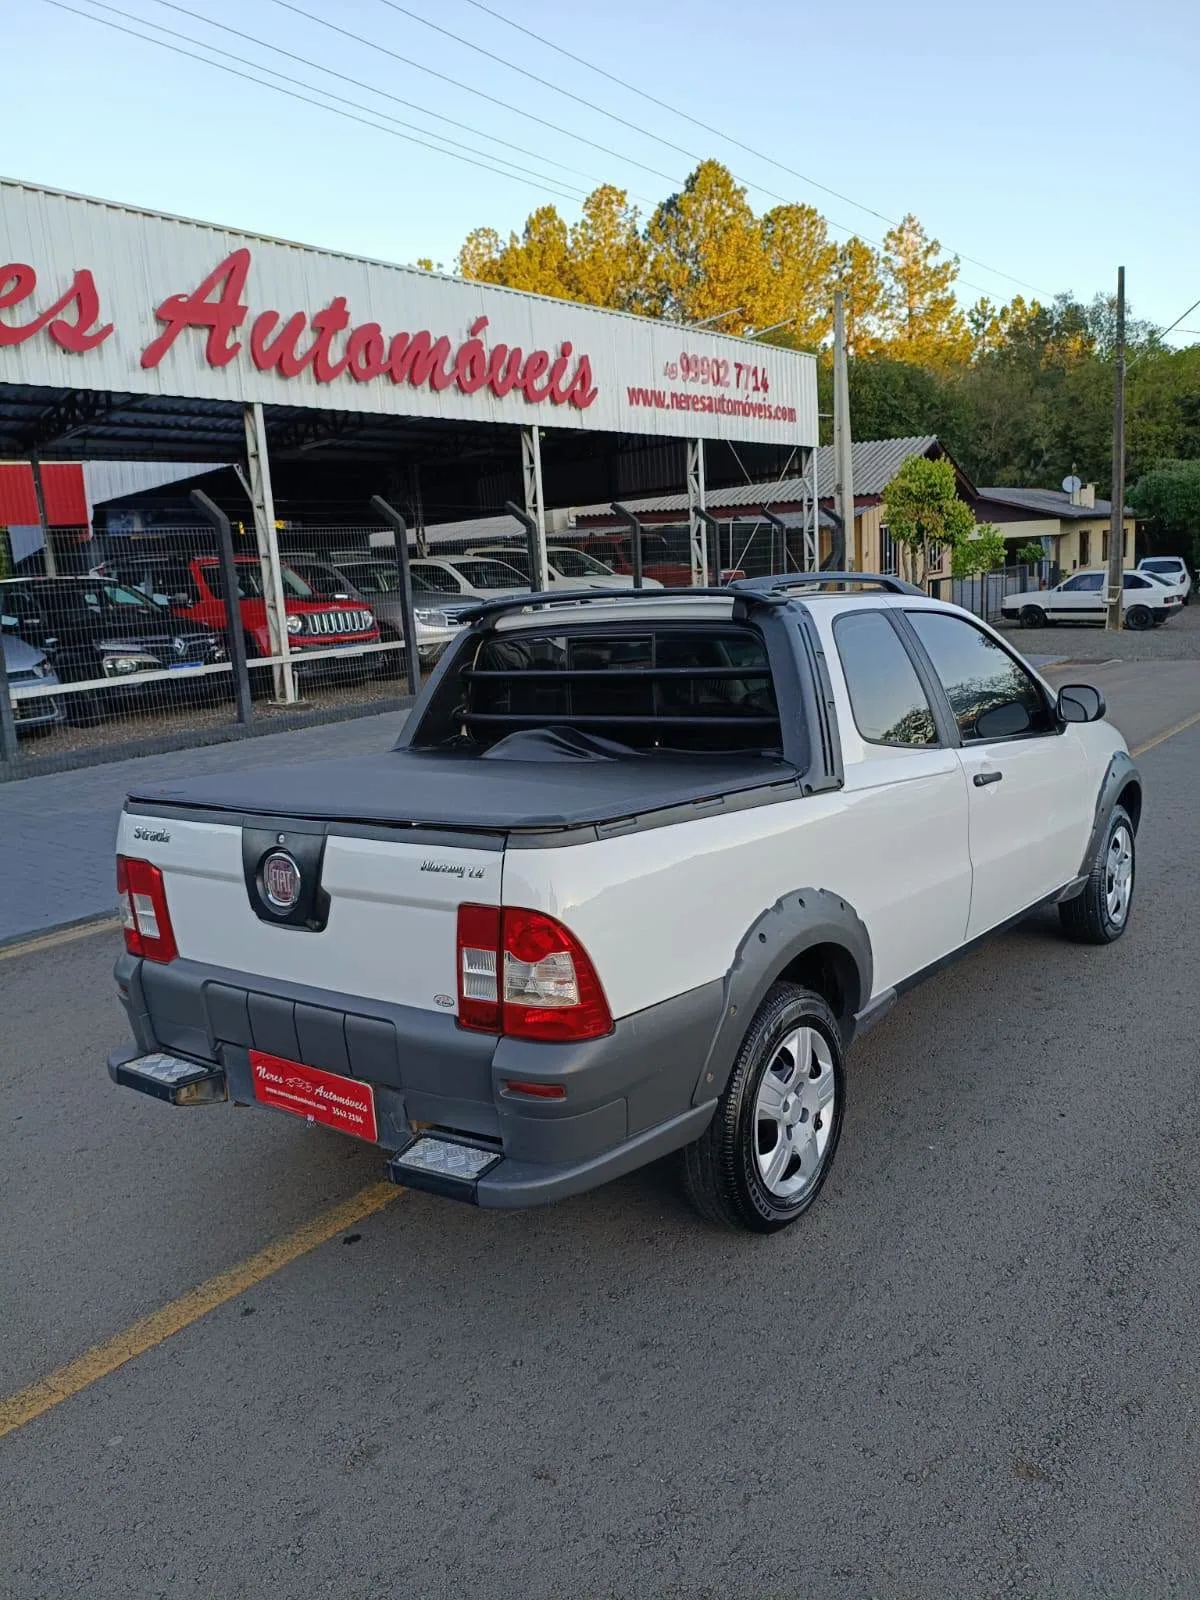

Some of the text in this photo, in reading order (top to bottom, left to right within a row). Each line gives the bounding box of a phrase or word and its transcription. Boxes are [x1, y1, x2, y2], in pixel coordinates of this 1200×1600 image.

[140, 247, 598, 409] Automóveis
[734, 362, 769, 393] 7714
[627, 386, 797, 422] www.neresautomóveis.com
[134, 825, 171, 843] Strada
[271, 868, 292, 893] FIAT
[256, 1065, 368, 1113] Neres Automóveis
